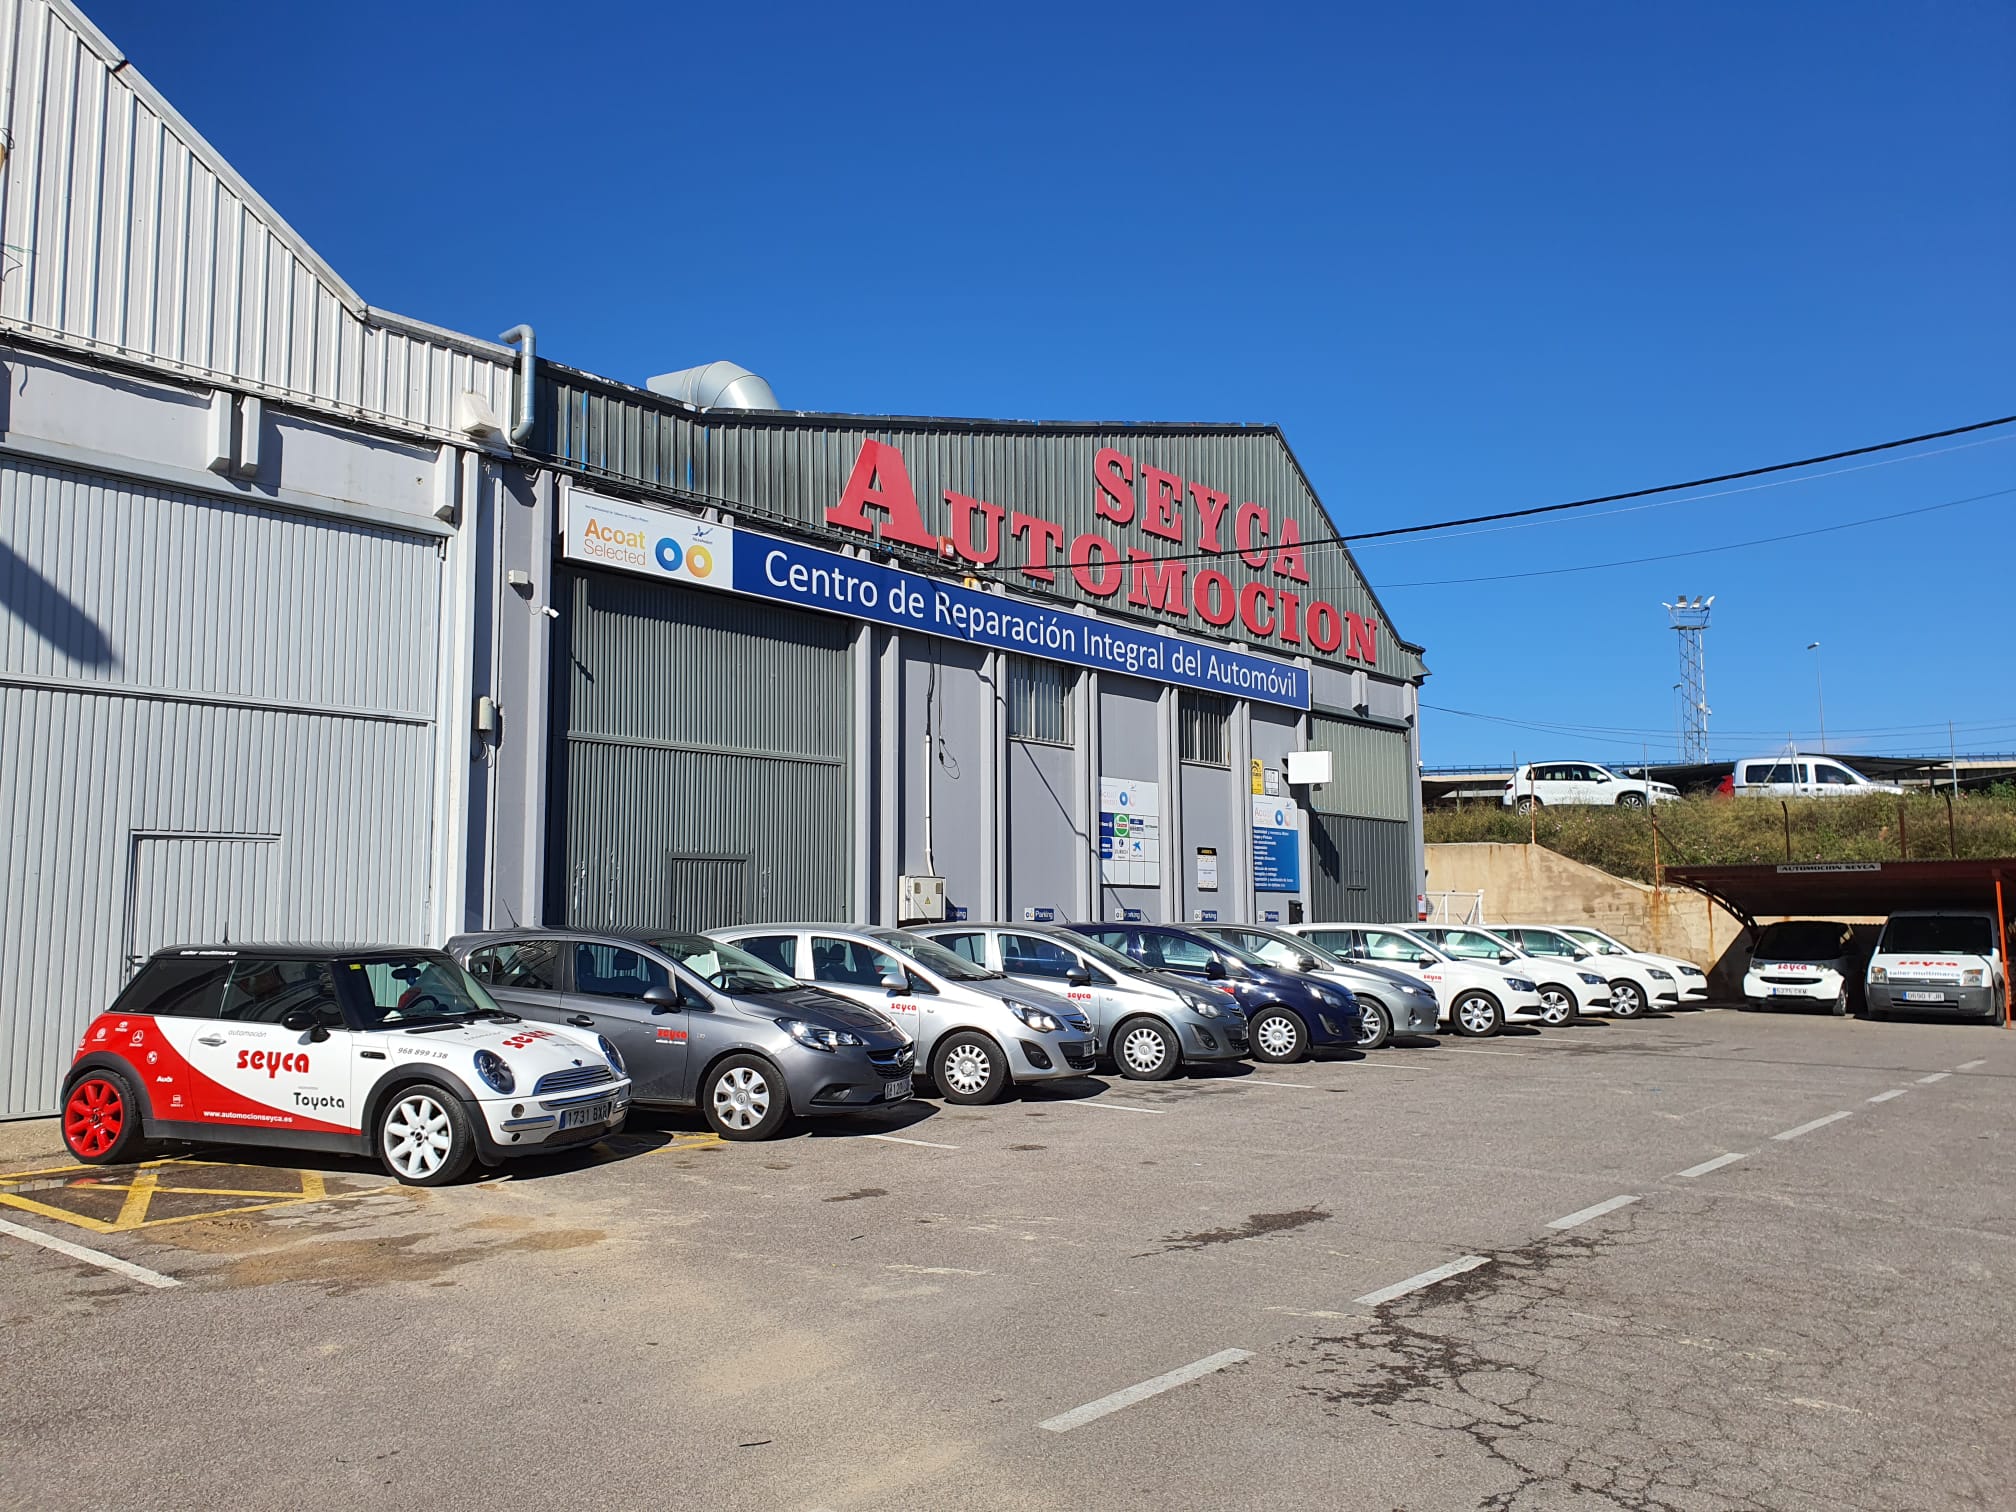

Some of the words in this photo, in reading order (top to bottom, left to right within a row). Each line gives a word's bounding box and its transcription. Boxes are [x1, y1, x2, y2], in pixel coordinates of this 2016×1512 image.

[1094, 447, 1309, 583] SEYCA
[584, 518, 646, 549] Acoat
[584, 538, 646, 566] Selected
[826, 438, 1376, 664] AUTOMOCION
[765, 550, 878, 607] Centro
[888, 579, 925, 618] de
[935, 591, 1075, 652] Reparación
[1084, 626, 1164, 672] Integral
[1171, 646, 1201, 677] del
[1207, 655, 1297, 698] Automóvil
[1035, 910, 1054, 919] Parking
[1202, 910, 1217, 919] Parking
[1067, 992, 1092, 1001] seyca
[890, 1003, 917, 1012] seyca
[398, 1047, 414, 1056] 968
[414, 1048, 431, 1057] 899
[432, 1050, 448, 1059] 138
[236, 1049, 310, 1079] seyca
[293, 1092, 345, 1111] Toyota
[203, 1110, 293, 1123] www.automocionseyca.es
[568, 1108, 590, 1127] 1731
